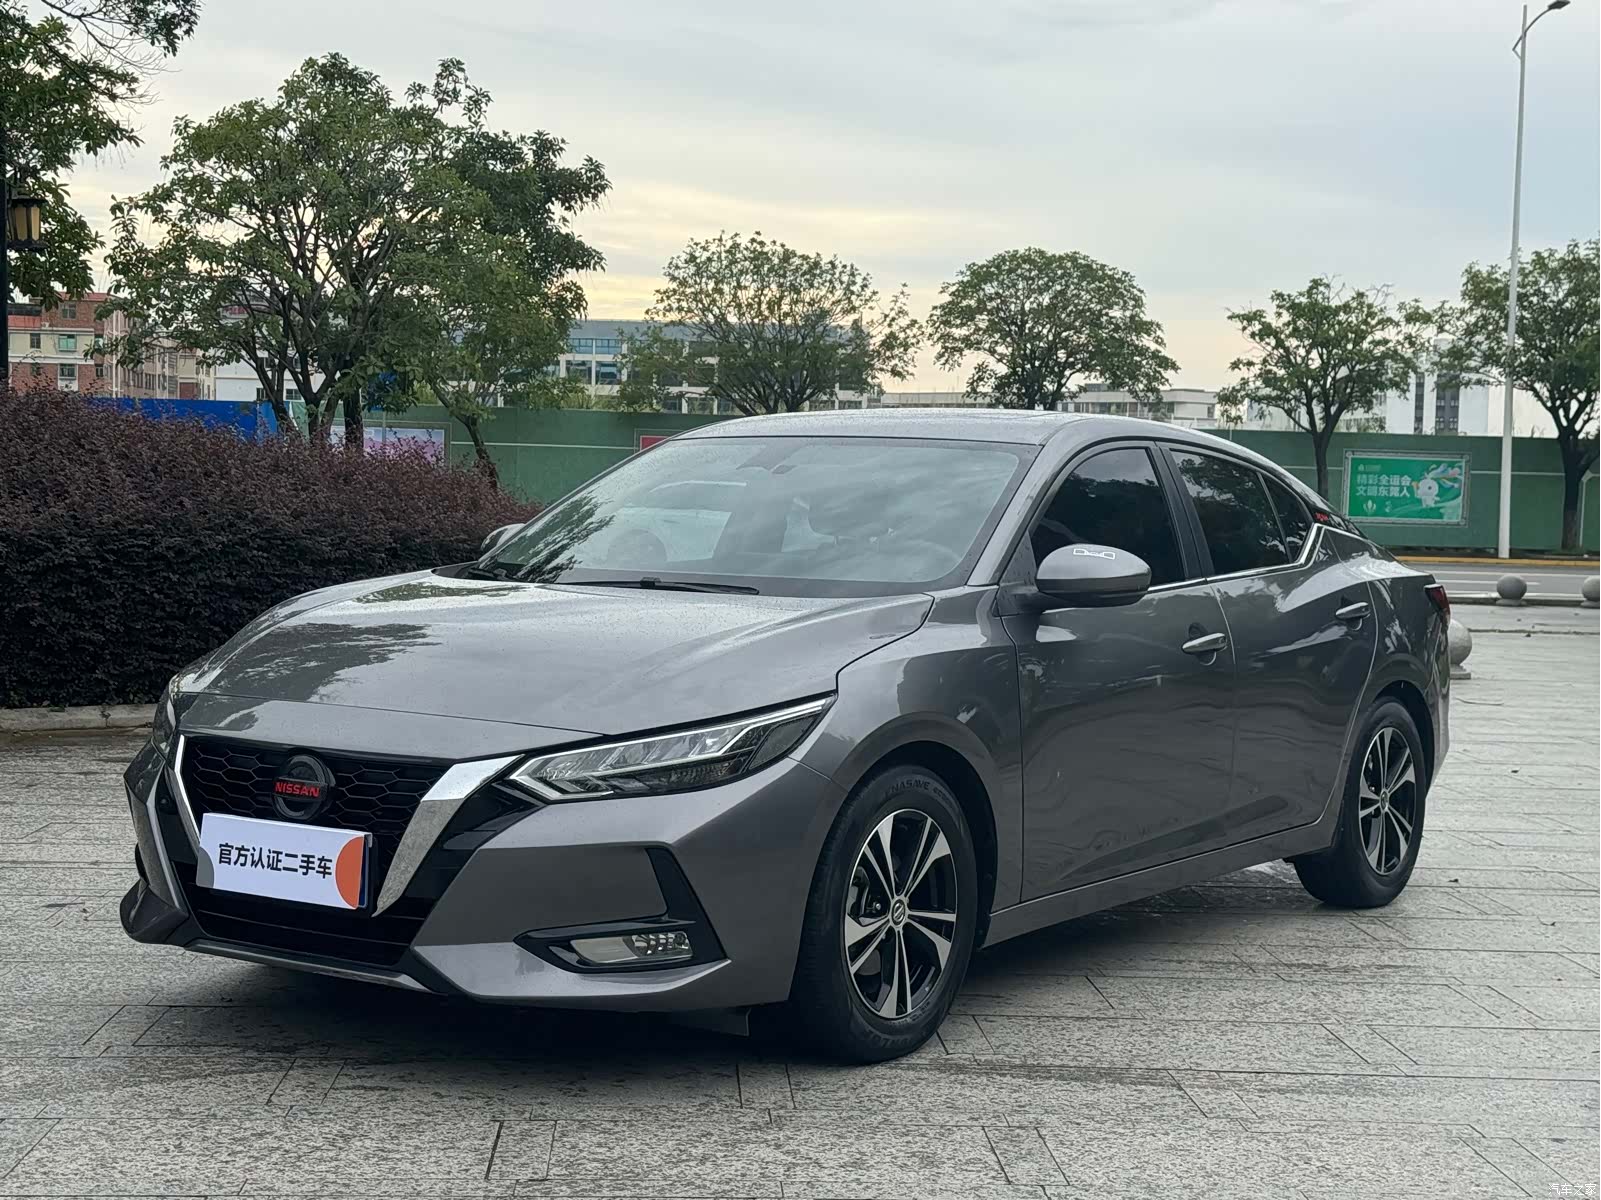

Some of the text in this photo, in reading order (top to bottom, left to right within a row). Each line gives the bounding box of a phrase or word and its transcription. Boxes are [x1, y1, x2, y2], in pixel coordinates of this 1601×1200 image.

[275, 782, 320, 797] NISSAN
[218, 842, 333, 879] 官方认证二手车
